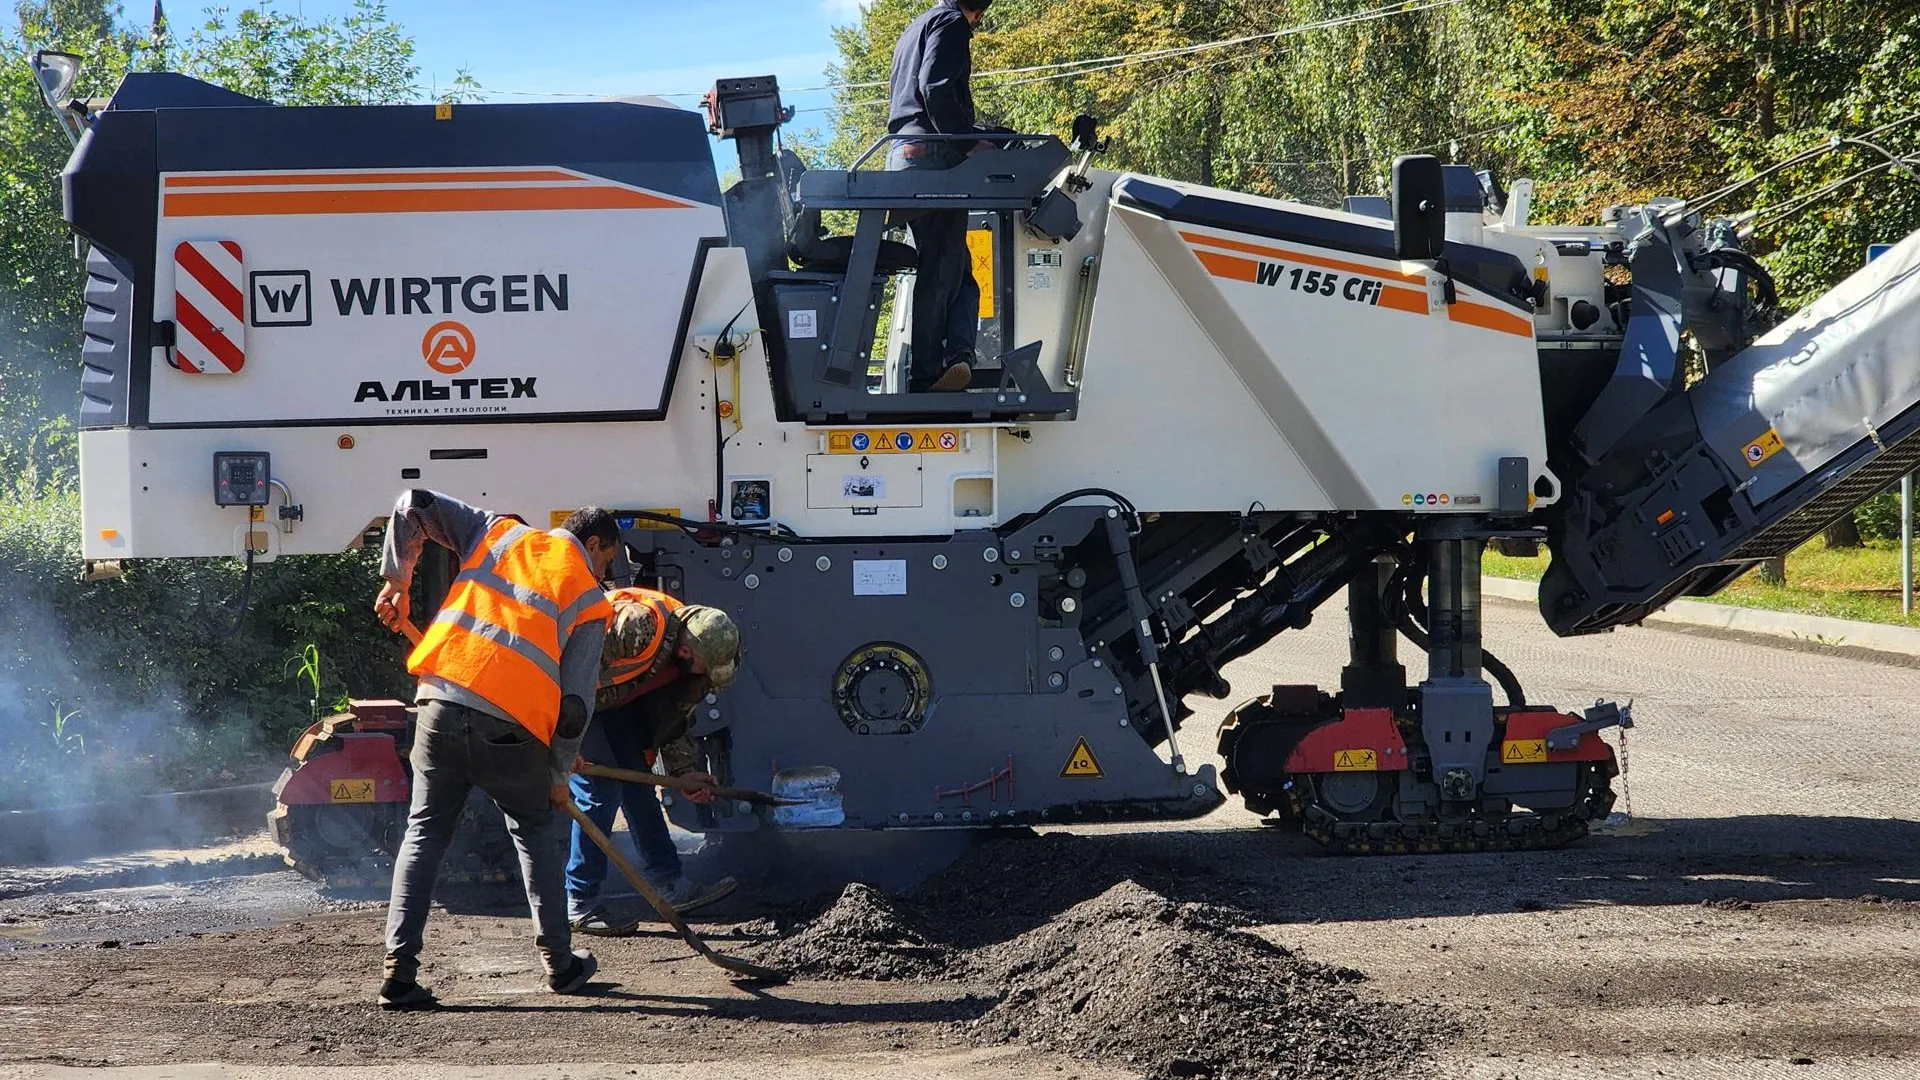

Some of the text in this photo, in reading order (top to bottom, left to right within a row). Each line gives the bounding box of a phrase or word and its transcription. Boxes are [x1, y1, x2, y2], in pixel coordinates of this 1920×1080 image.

[330, 273, 569, 316] WIRTGEN
[1256, 262, 1383, 306] W 155 CFi
[353, 376, 538, 403] АЛЬТЕХ
[443, 405, 507, 413] ТЕХНОЛОГИИ
